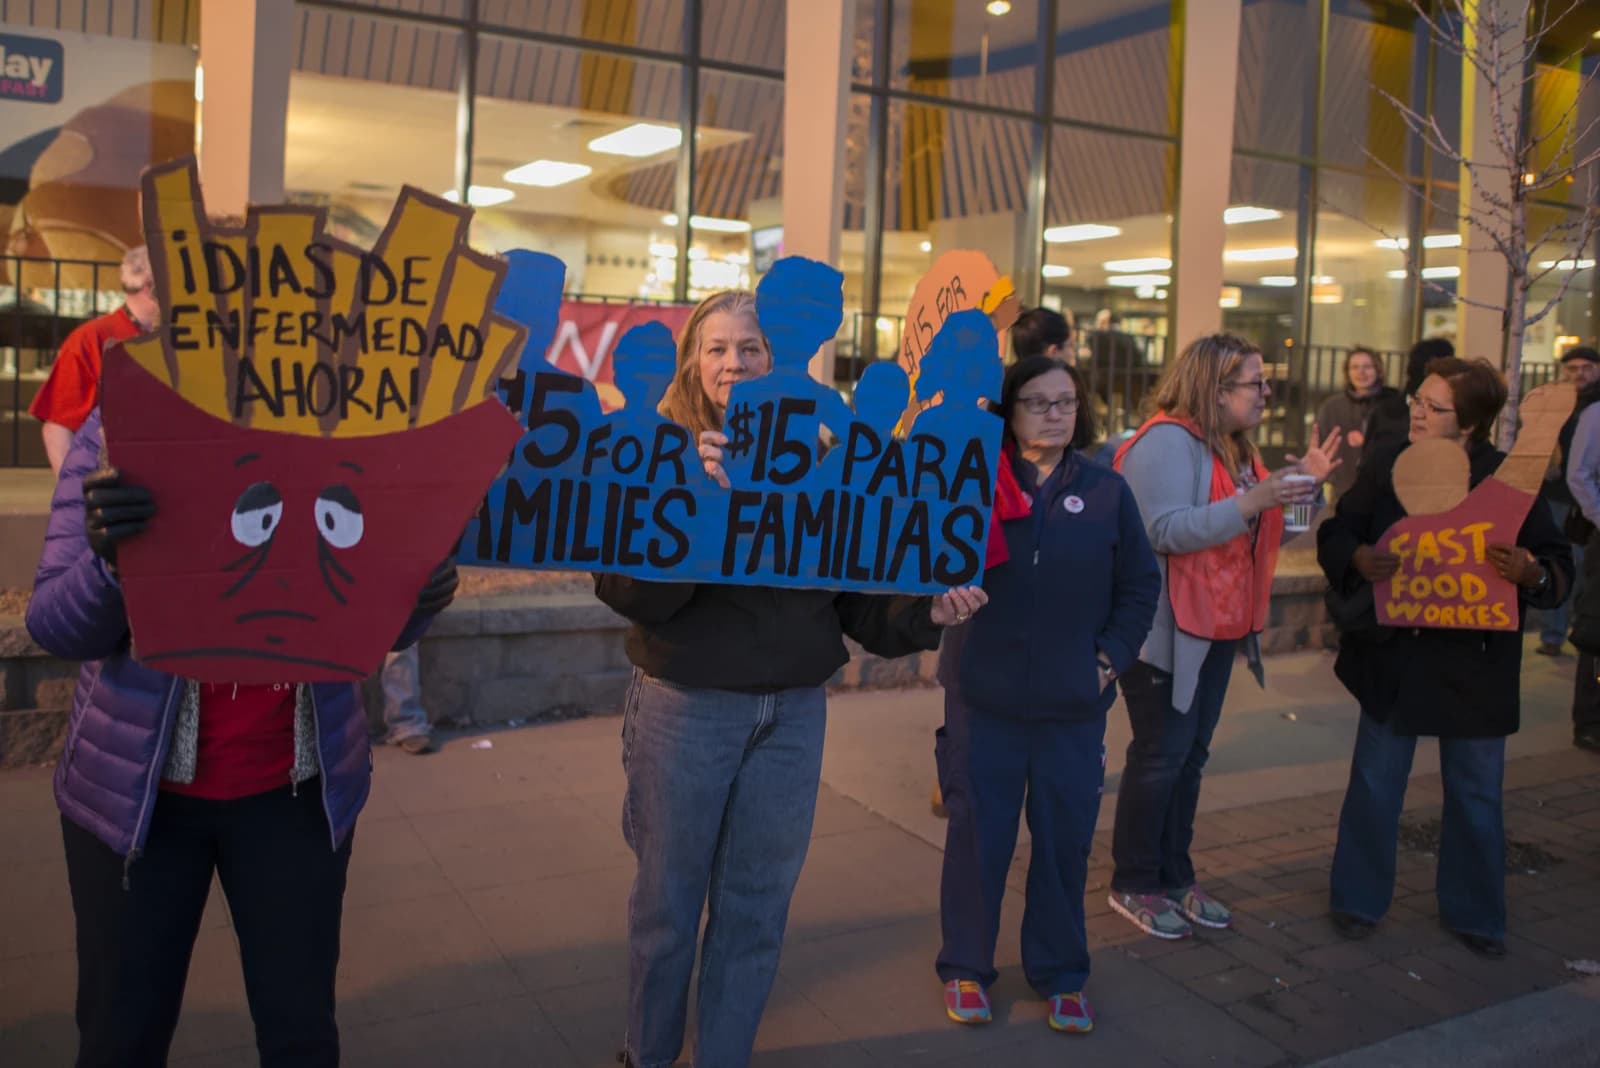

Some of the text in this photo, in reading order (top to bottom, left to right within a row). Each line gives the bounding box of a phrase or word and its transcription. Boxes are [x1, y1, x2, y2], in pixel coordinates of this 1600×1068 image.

[360, 253, 432, 306] DE
[935, 275, 967, 325] FOR
[170, 305, 484, 362] ENFERMEDAD
[235, 357, 419, 424] AHORA!
[498, 369, 689, 485] 15 FOR
[724, 397, 992, 507] $15 PARA
[453, 477, 697, 568] AMILIES
[721, 489, 984, 586] FAMILIAS
[1388, 522, 1495, 573] FAST
[1385, 602, 1511, 627] WORKES
[1391, 572, 1487, 602] FOOD
